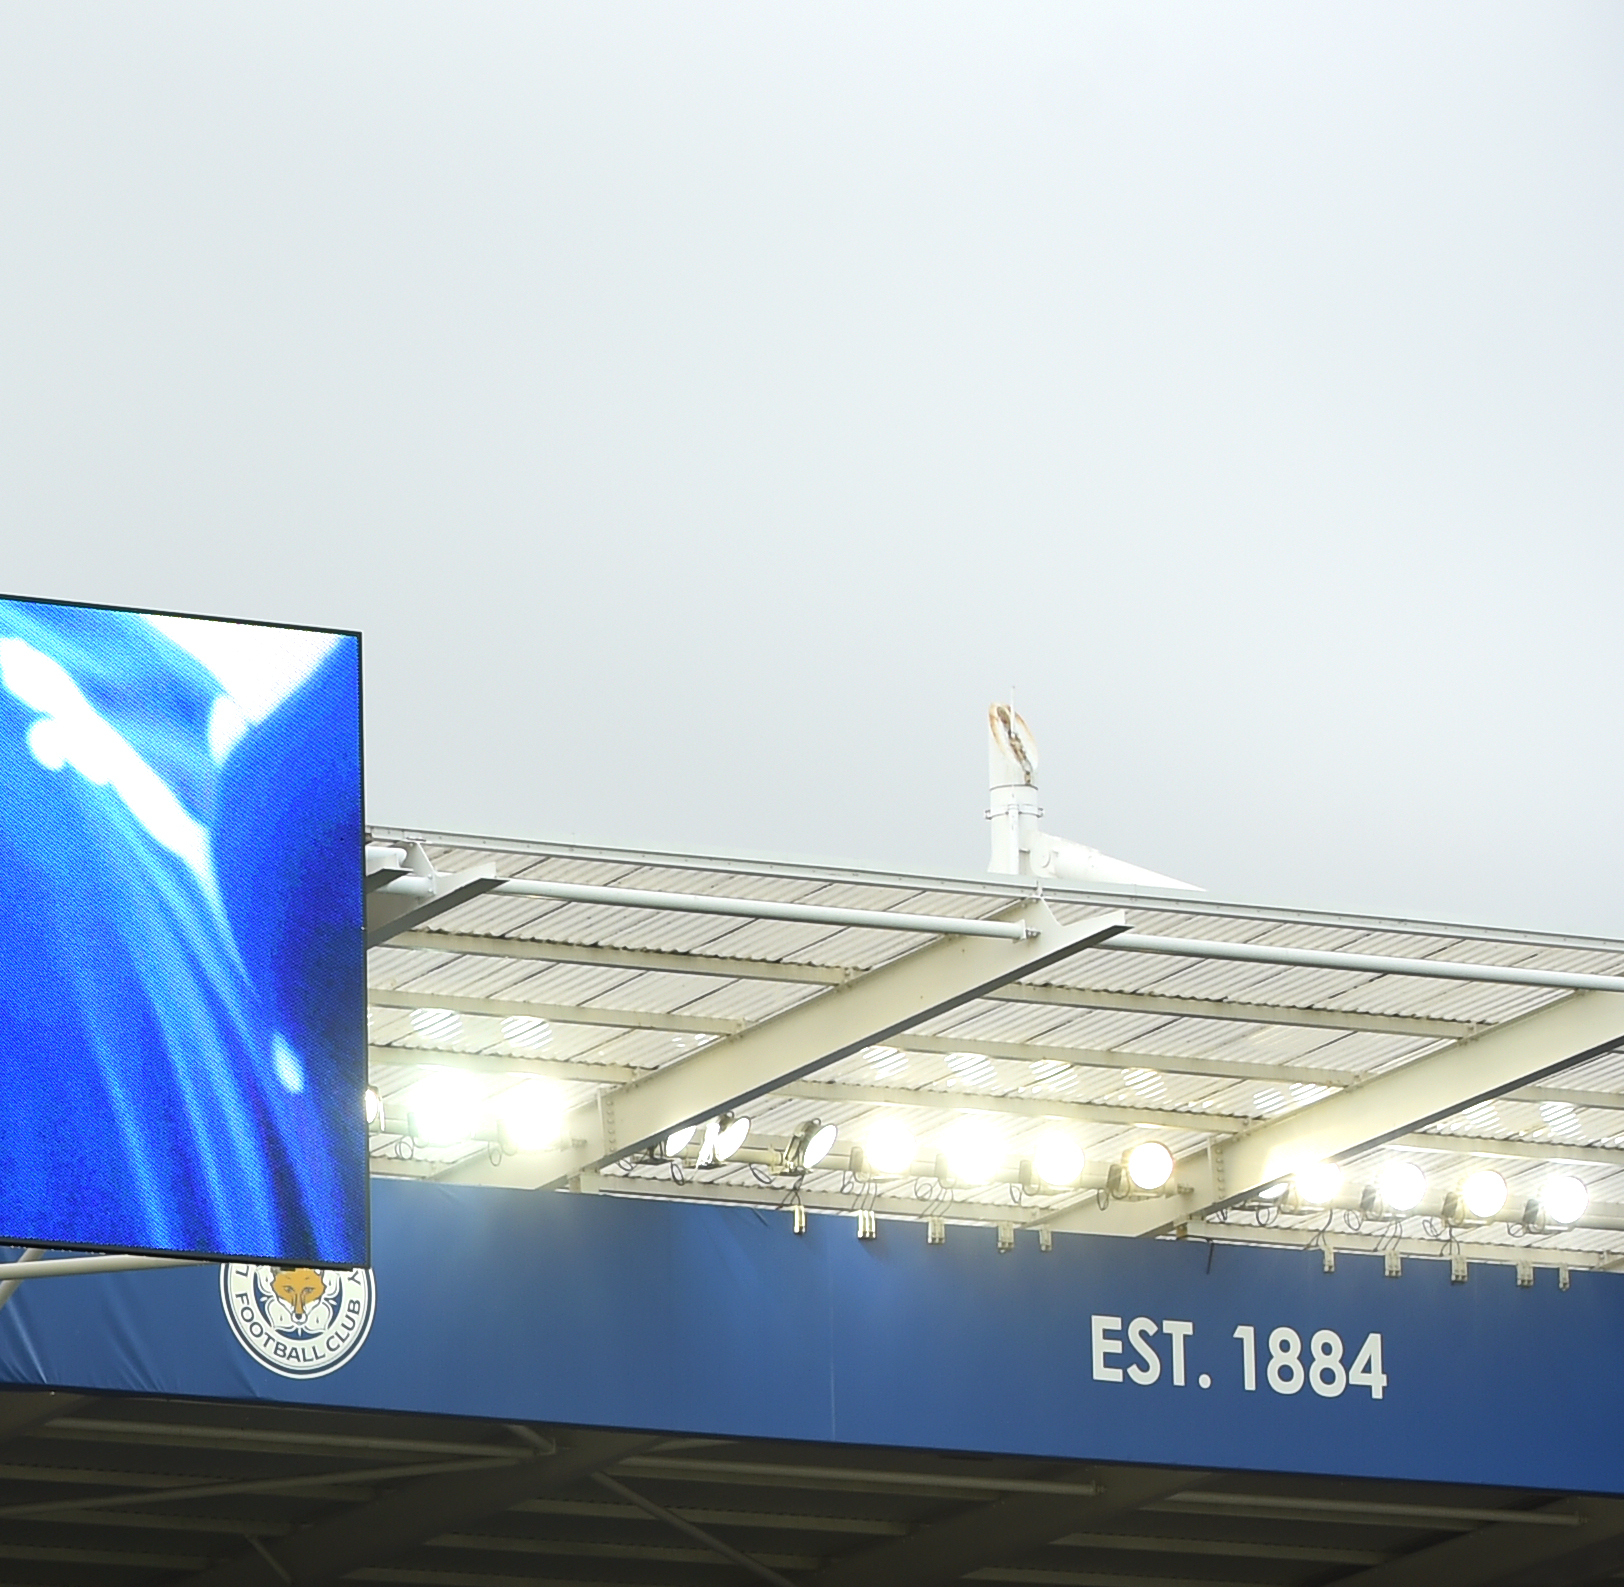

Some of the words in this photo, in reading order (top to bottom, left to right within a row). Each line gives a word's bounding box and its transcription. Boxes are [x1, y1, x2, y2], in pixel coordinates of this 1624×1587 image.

[235, 1291, 327, 1363] FOOTBALL
[327, 1299, 361, 1352] CLUB
[1090, 1314, 1212, 1391] EST.
[1232, 1324, 1388, 1400] 1884
